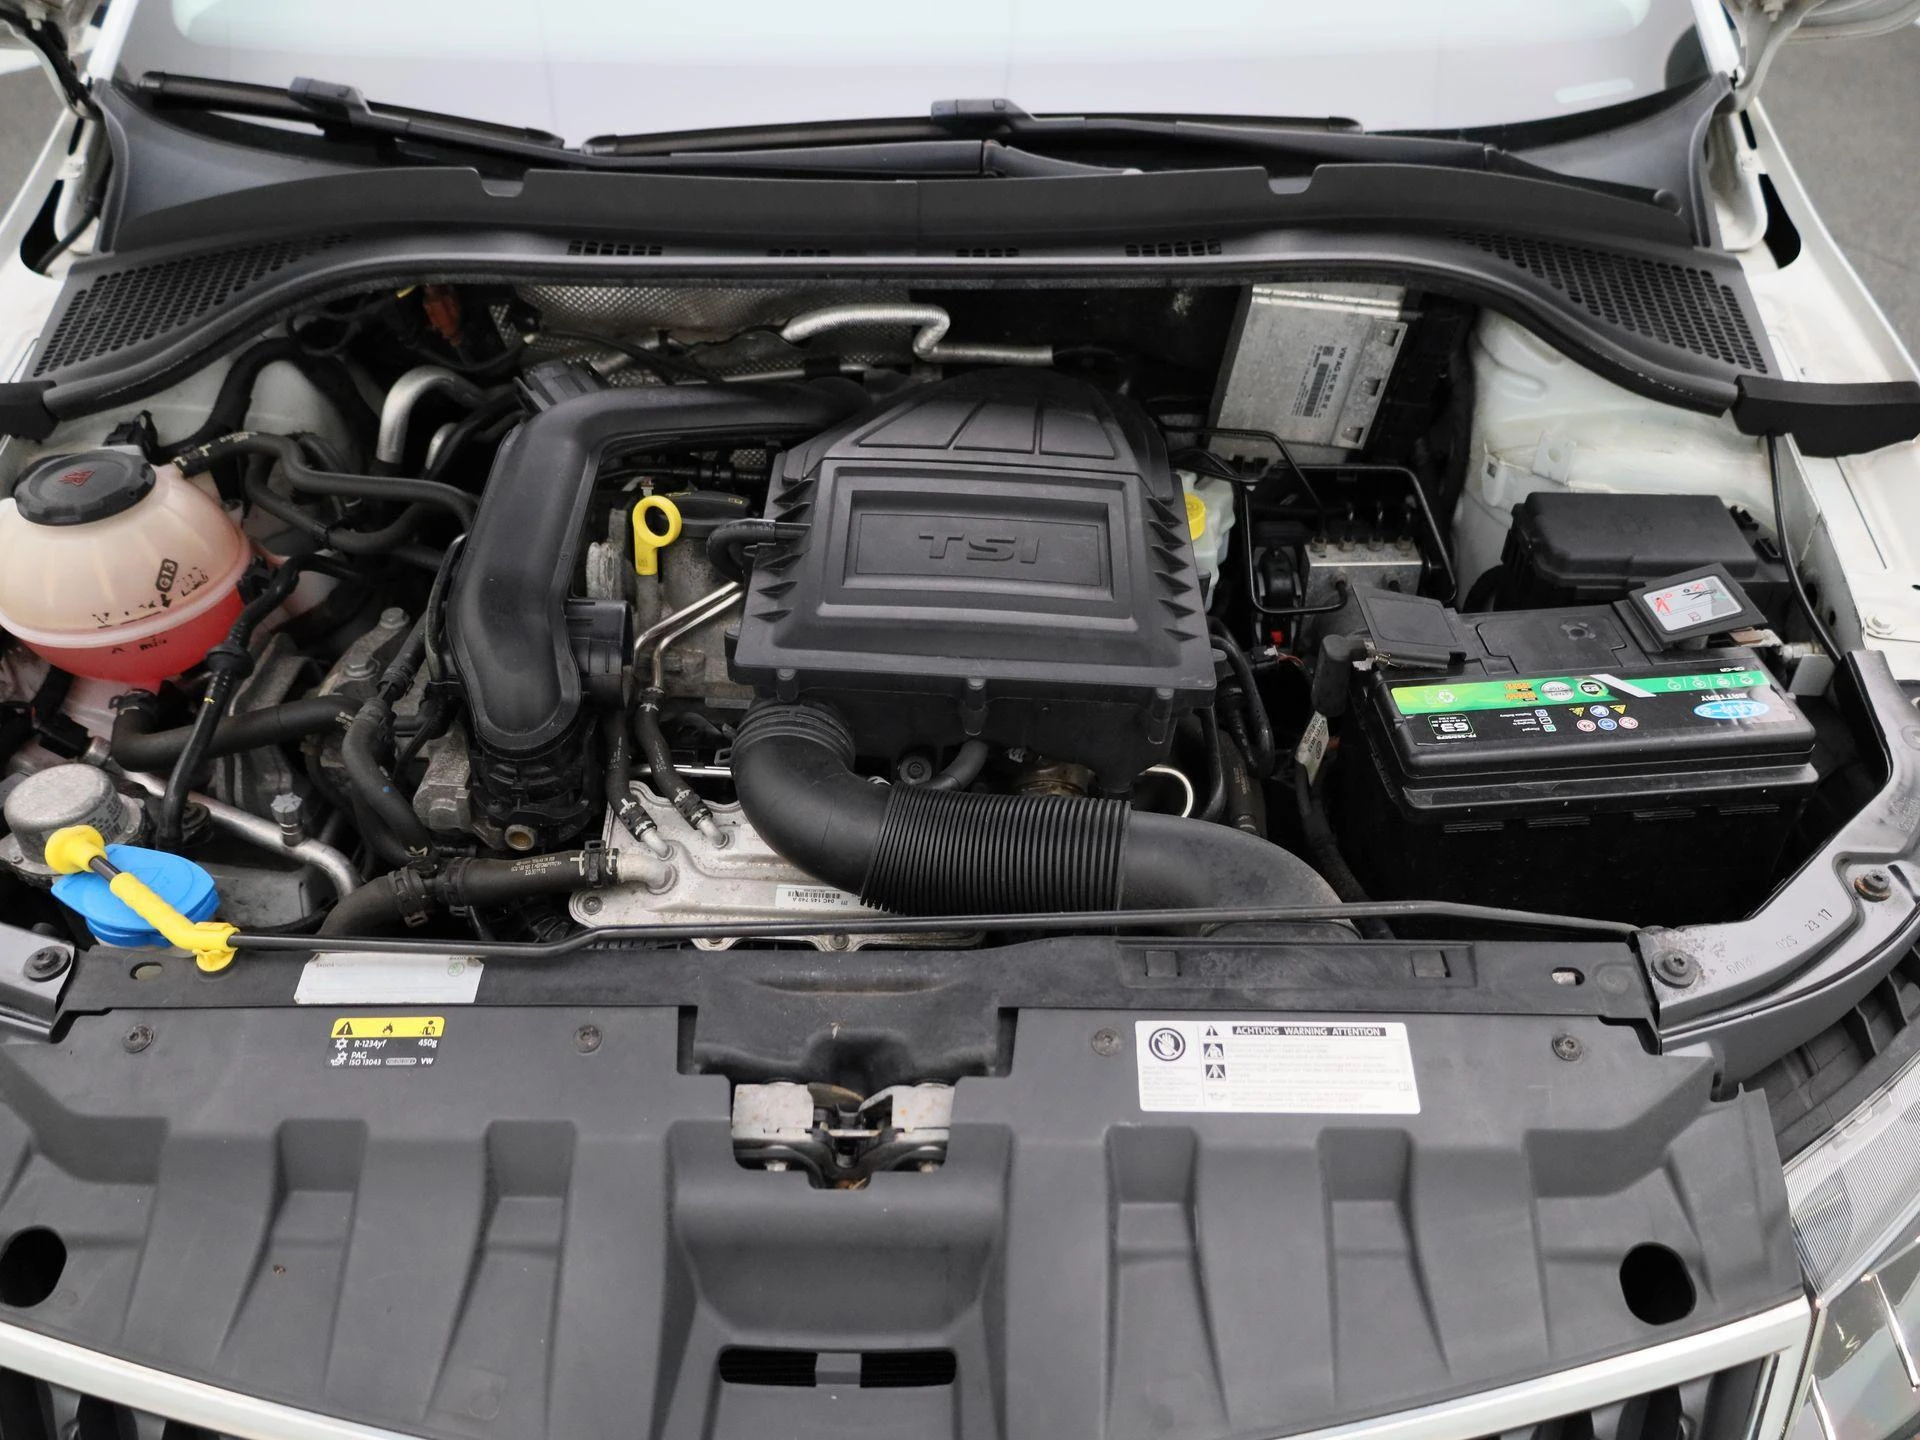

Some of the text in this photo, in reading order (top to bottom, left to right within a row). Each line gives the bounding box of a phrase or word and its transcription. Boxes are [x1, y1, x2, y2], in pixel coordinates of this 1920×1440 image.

[918, 531, 1041, 565] TSI
[158, 561, 176, 590] G13
[1235, 1026, 1381, 1037] ACHTUNG WARNING ATTENTION
[354, 1039, 438, 1050] R-1234yf 450g
[351, 1051, 368, 1059] PAG
[349, 1058, 361, 1066] ISO
[362, 1058, 382, 1066] 13043
[421, 1057, 434, 1065] VW
